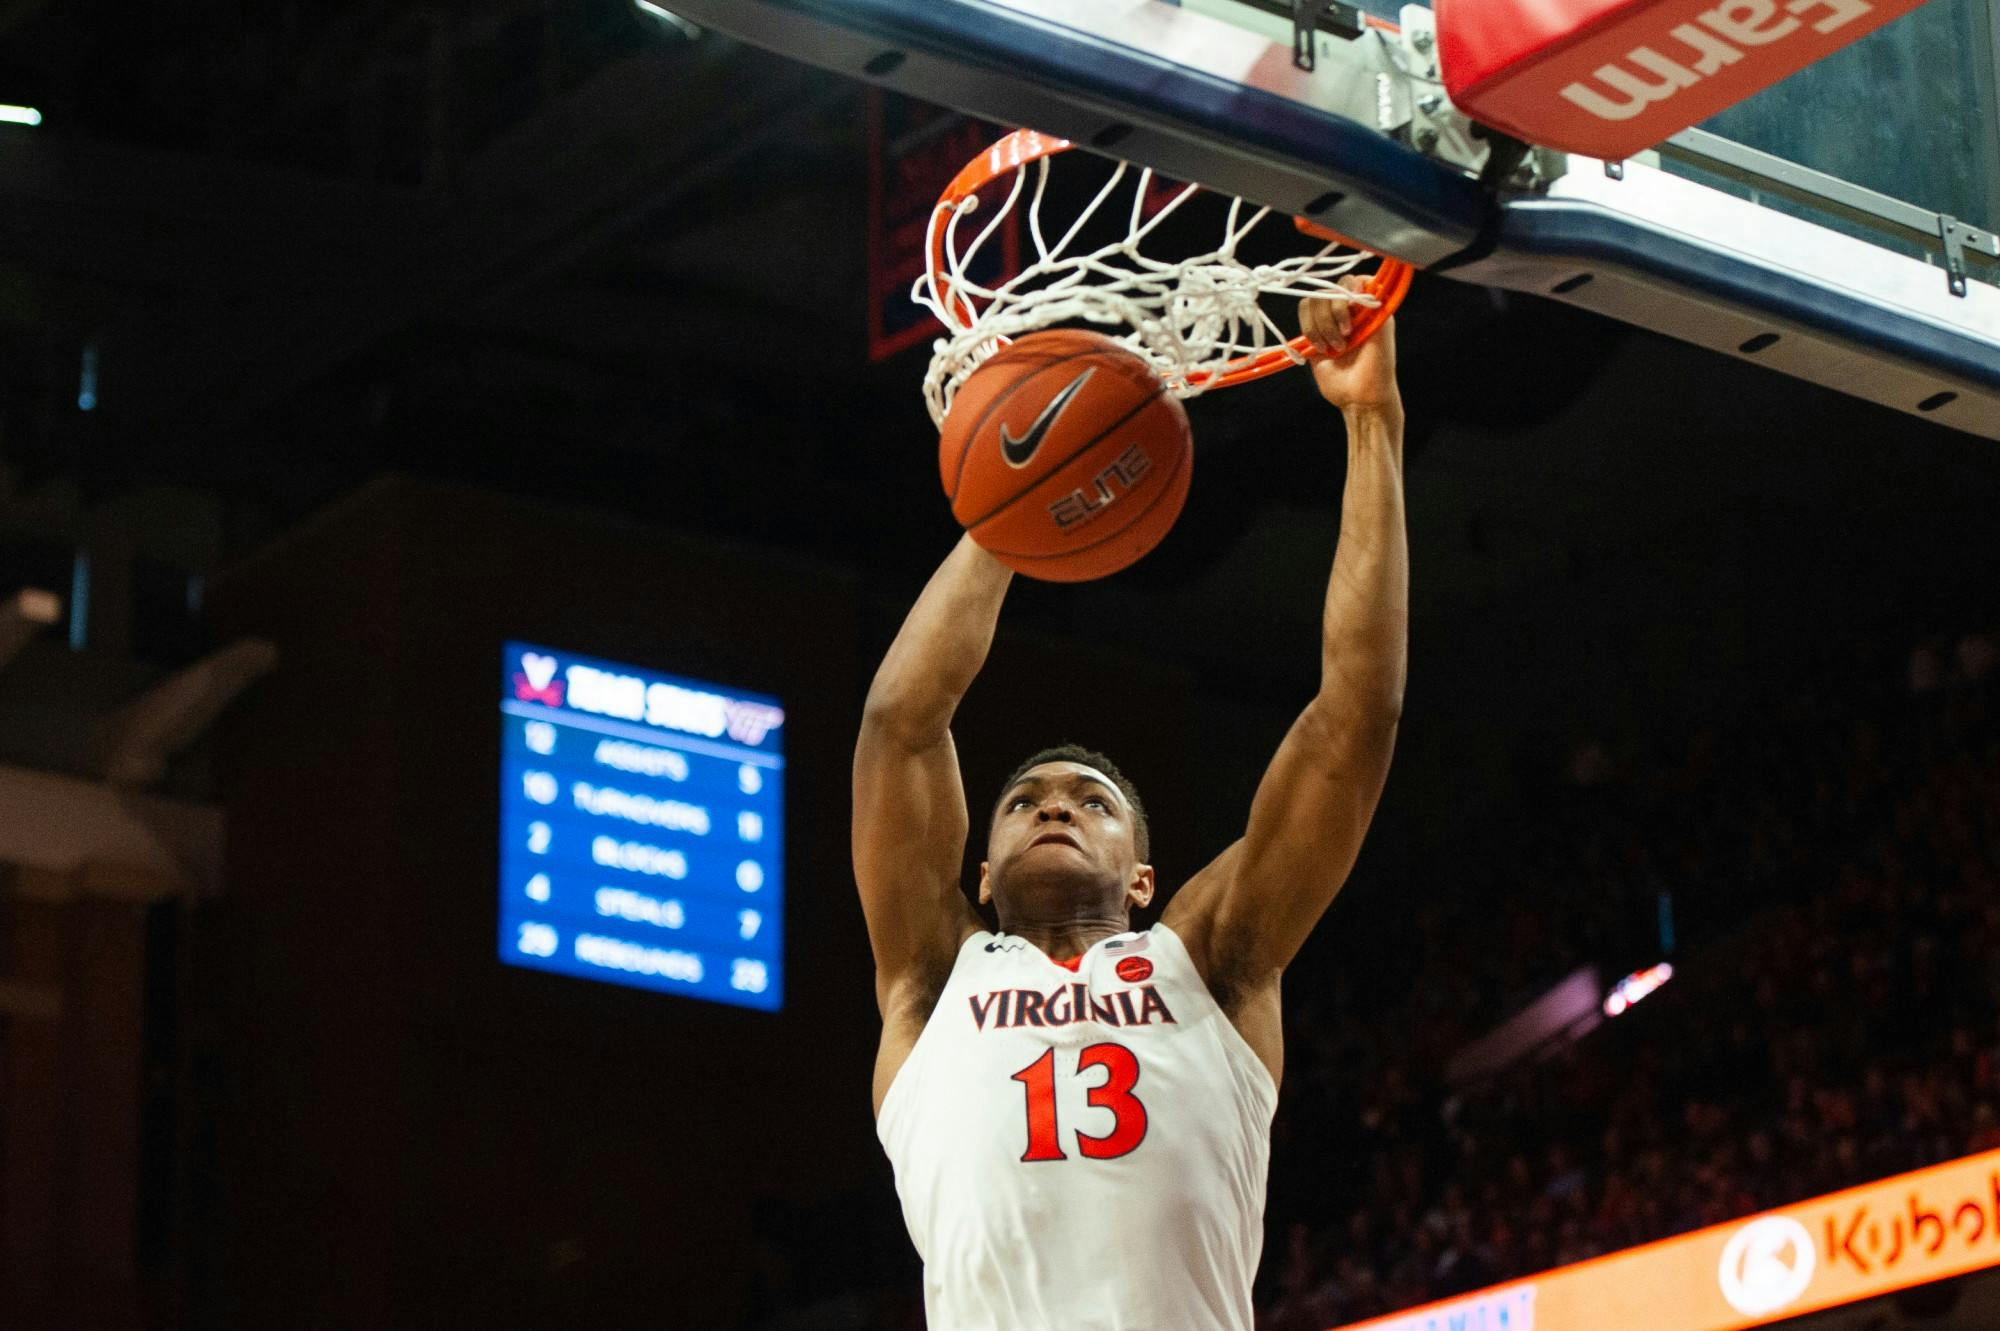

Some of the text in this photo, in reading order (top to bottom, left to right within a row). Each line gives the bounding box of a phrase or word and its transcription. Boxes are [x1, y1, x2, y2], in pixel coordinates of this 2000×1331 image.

[1557, 0, 1874, 121] Farm
[1047, 442, 1152, 534] ELITE
[968, 983, 1178, 1033] VIRGINIA
[1011, 1042, 1148, 1162] 13
